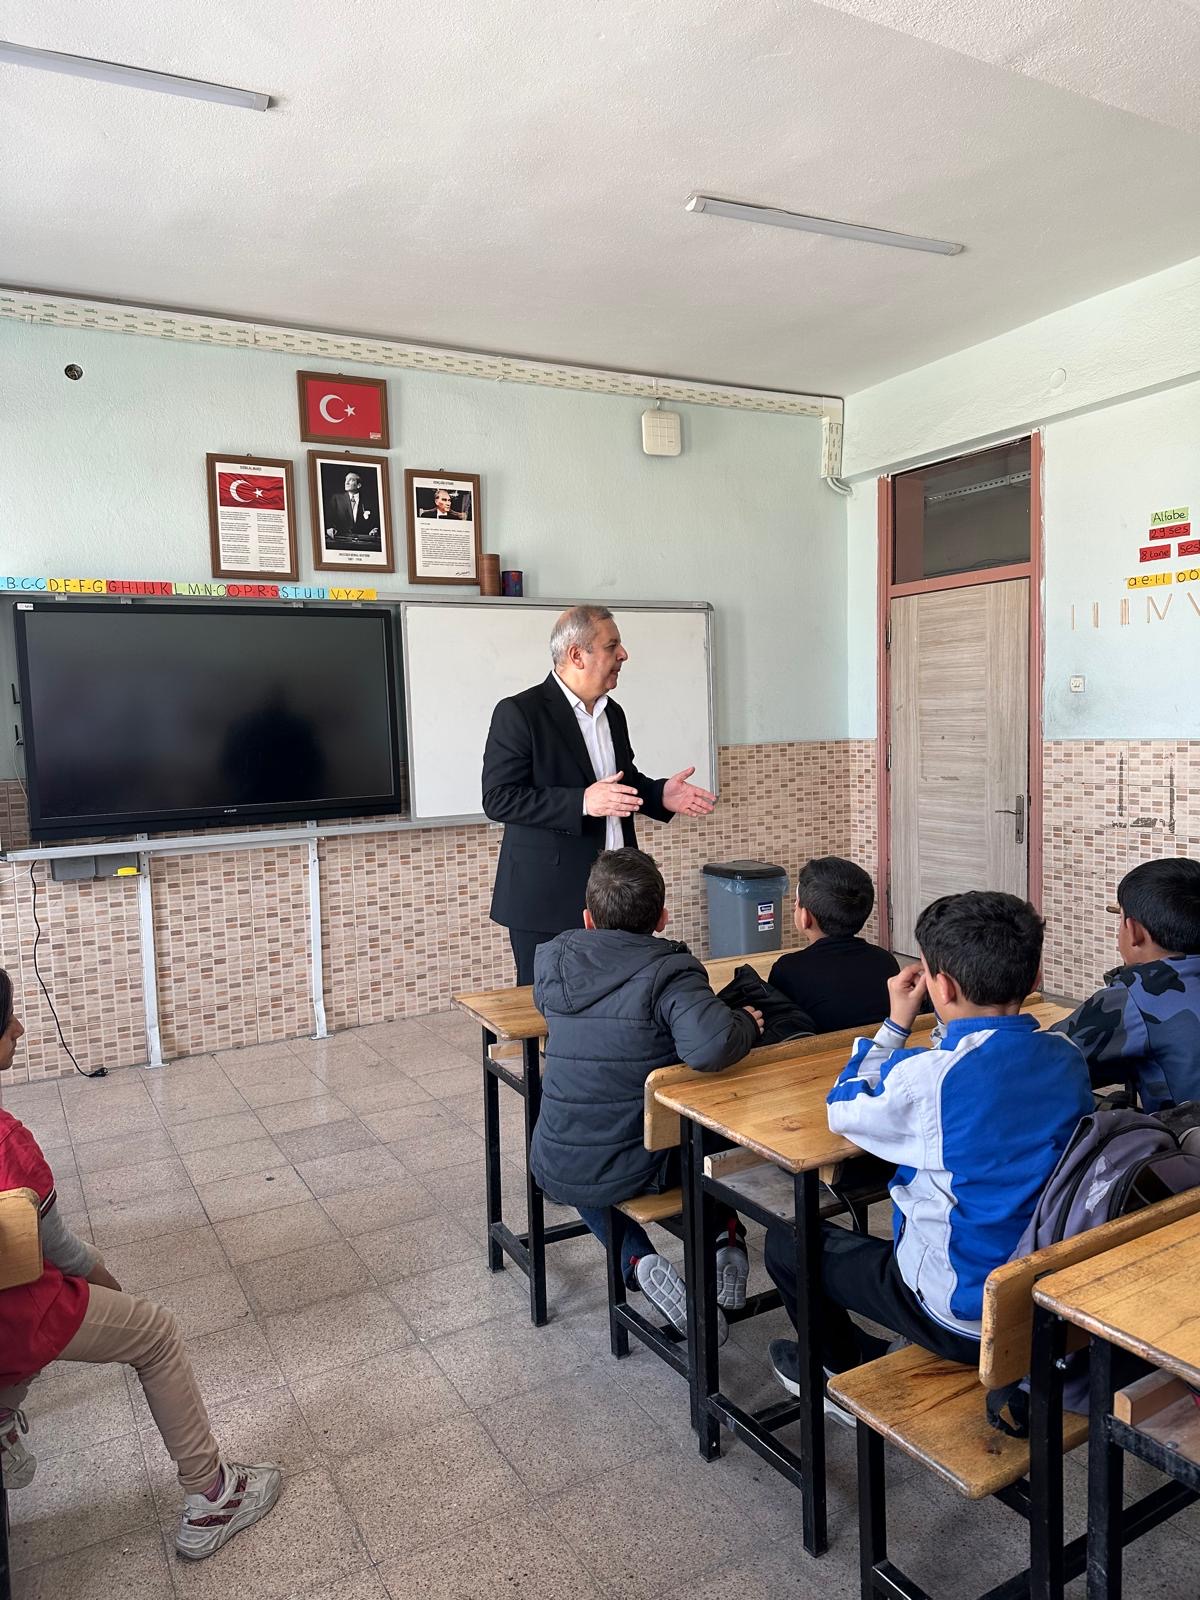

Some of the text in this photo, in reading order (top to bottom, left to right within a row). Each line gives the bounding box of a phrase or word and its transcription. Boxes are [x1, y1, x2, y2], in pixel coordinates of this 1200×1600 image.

[1152, 509, 1186, 523] Alfabe
[1168, 526, 1189, 535] ses
[1141, 550, 1148, 560] 8
